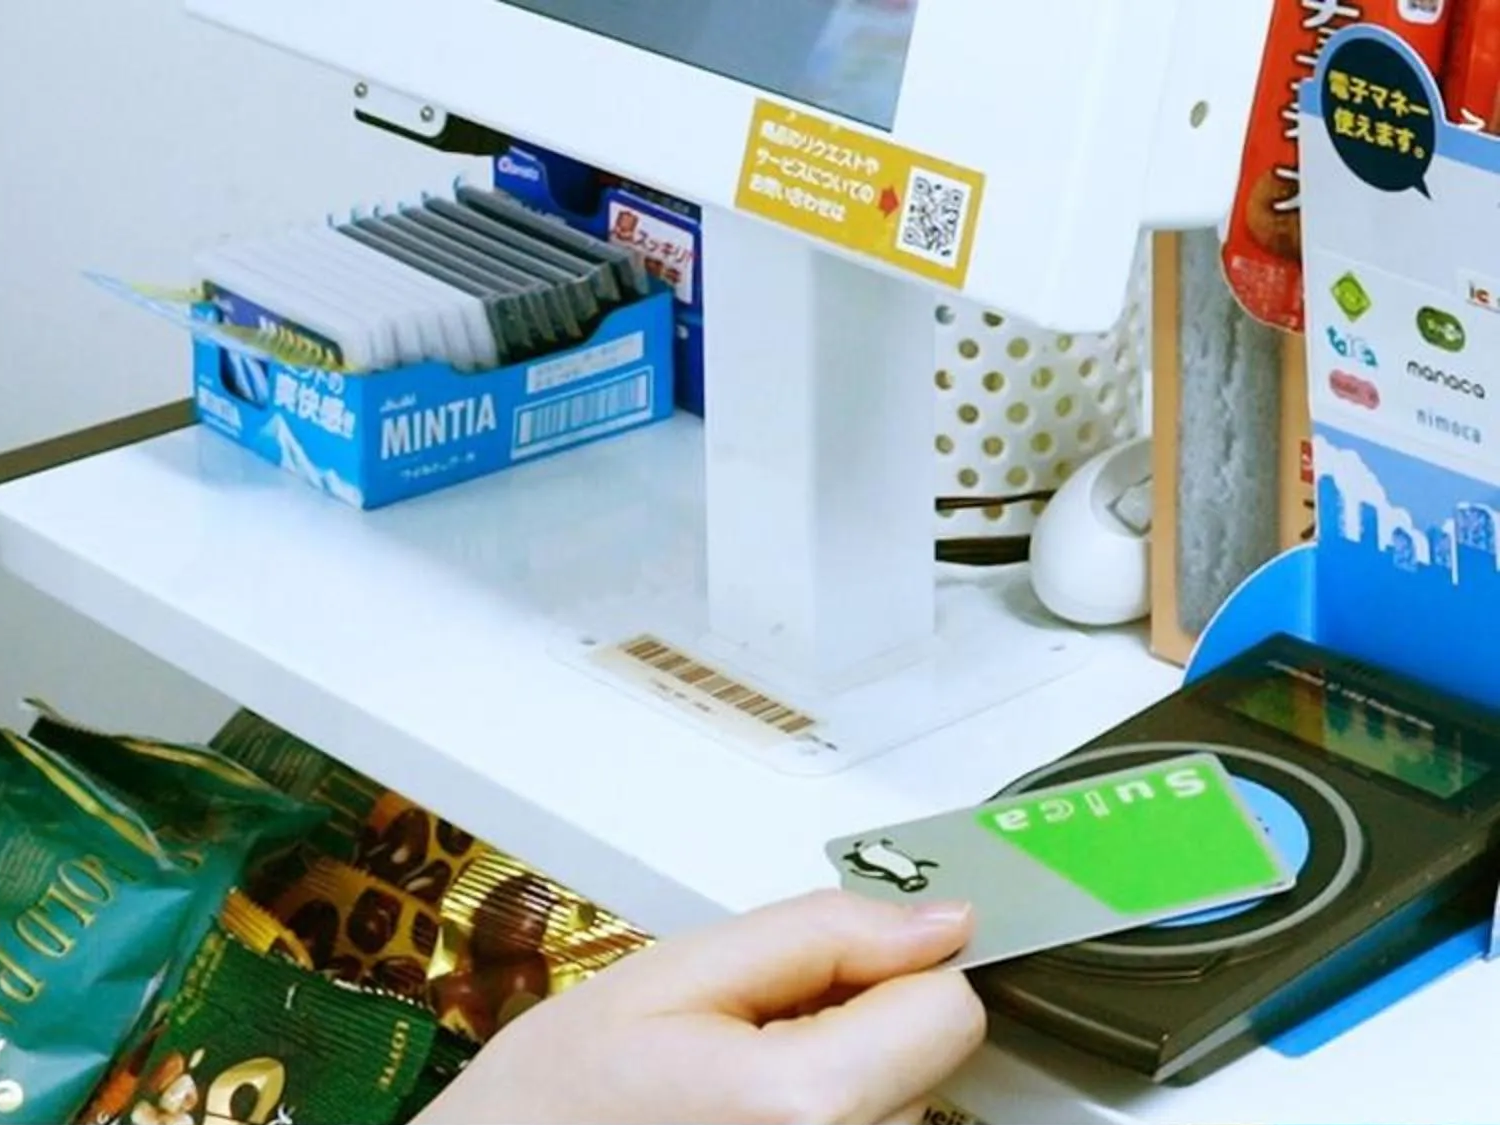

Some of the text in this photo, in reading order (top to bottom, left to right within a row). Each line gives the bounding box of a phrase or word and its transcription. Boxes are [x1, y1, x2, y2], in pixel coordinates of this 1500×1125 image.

[1328, 69, 1430, 117] 電子マネー
[1333, 107, 1426, 160] 使えます。
[1405, 360, 1486, 401] manaca
[380, 393, 498, 460] MINTIA
[1416, 408, 1483, 445] nimoca
[994, 768, 1208, 834] Suica
